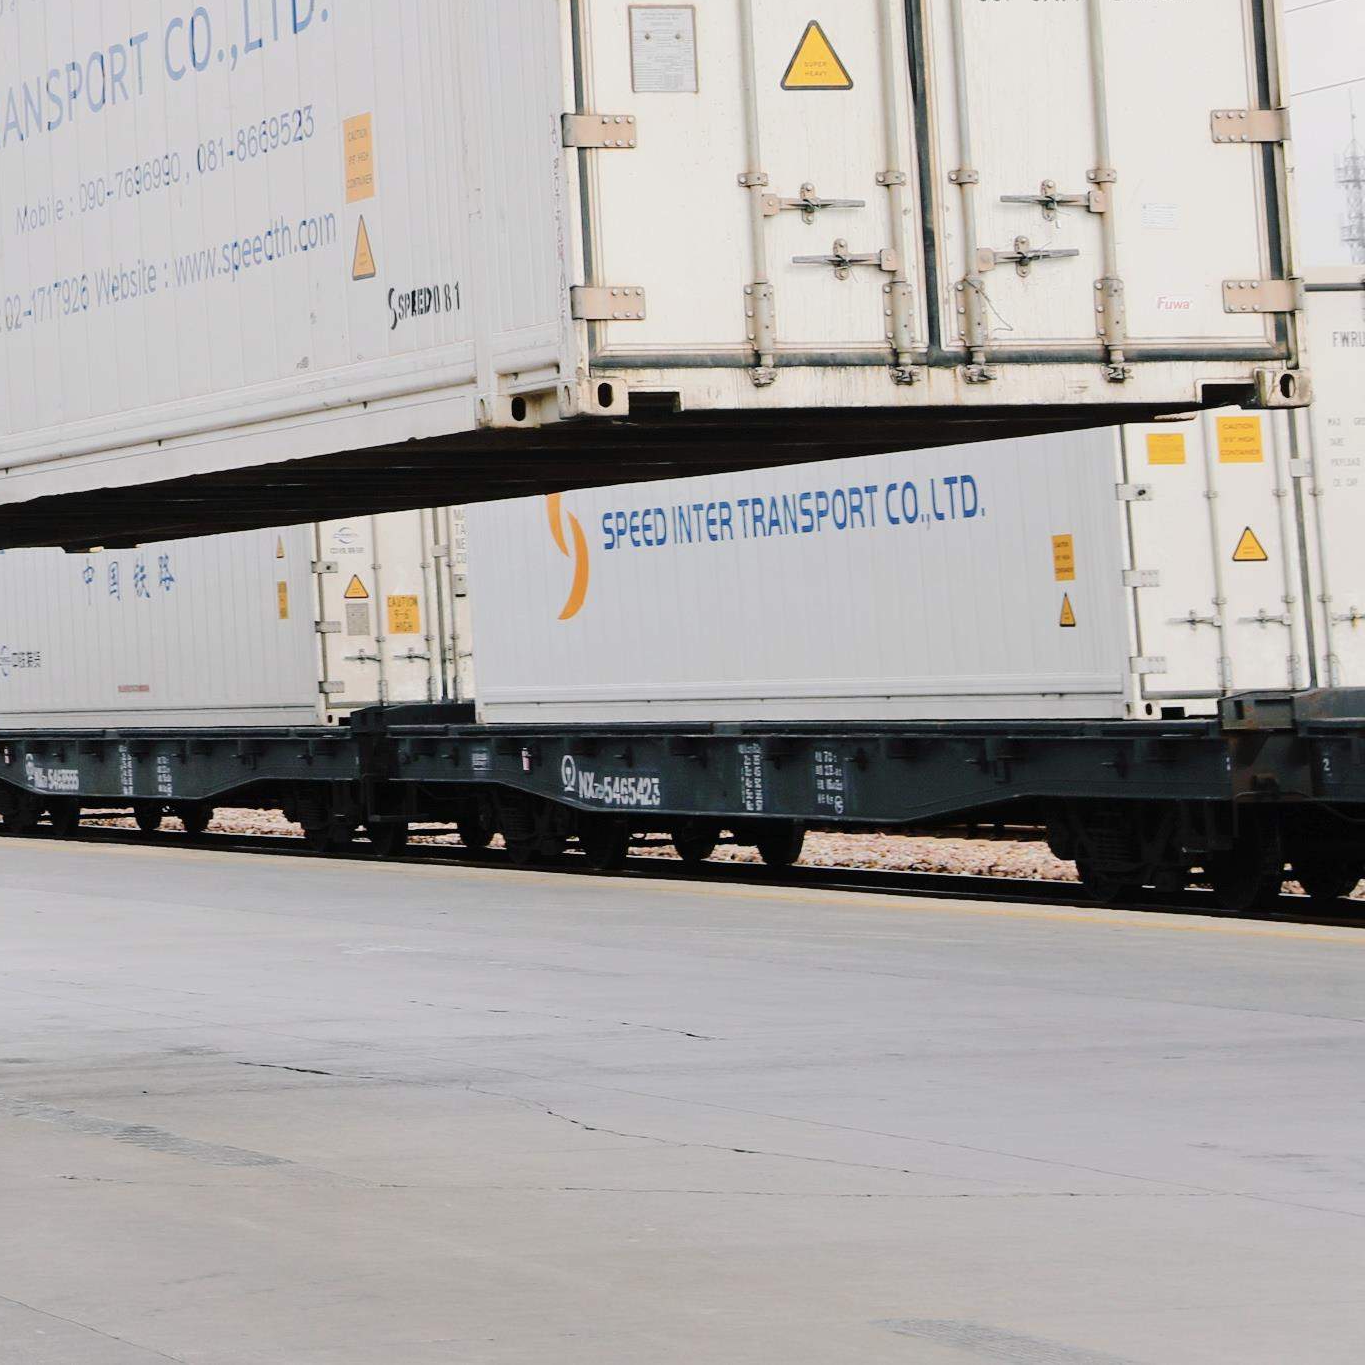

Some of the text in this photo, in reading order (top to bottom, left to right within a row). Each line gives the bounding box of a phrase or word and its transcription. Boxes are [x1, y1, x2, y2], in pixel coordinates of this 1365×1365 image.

[17, 193, 65, 235] Mobile
[94, 258, 158, 309] Website
[1156, 296, 1191, 310] Fuwa
[602, 474, 987, 550] SPEED INTER TRANSPORT CO.,LTD.
